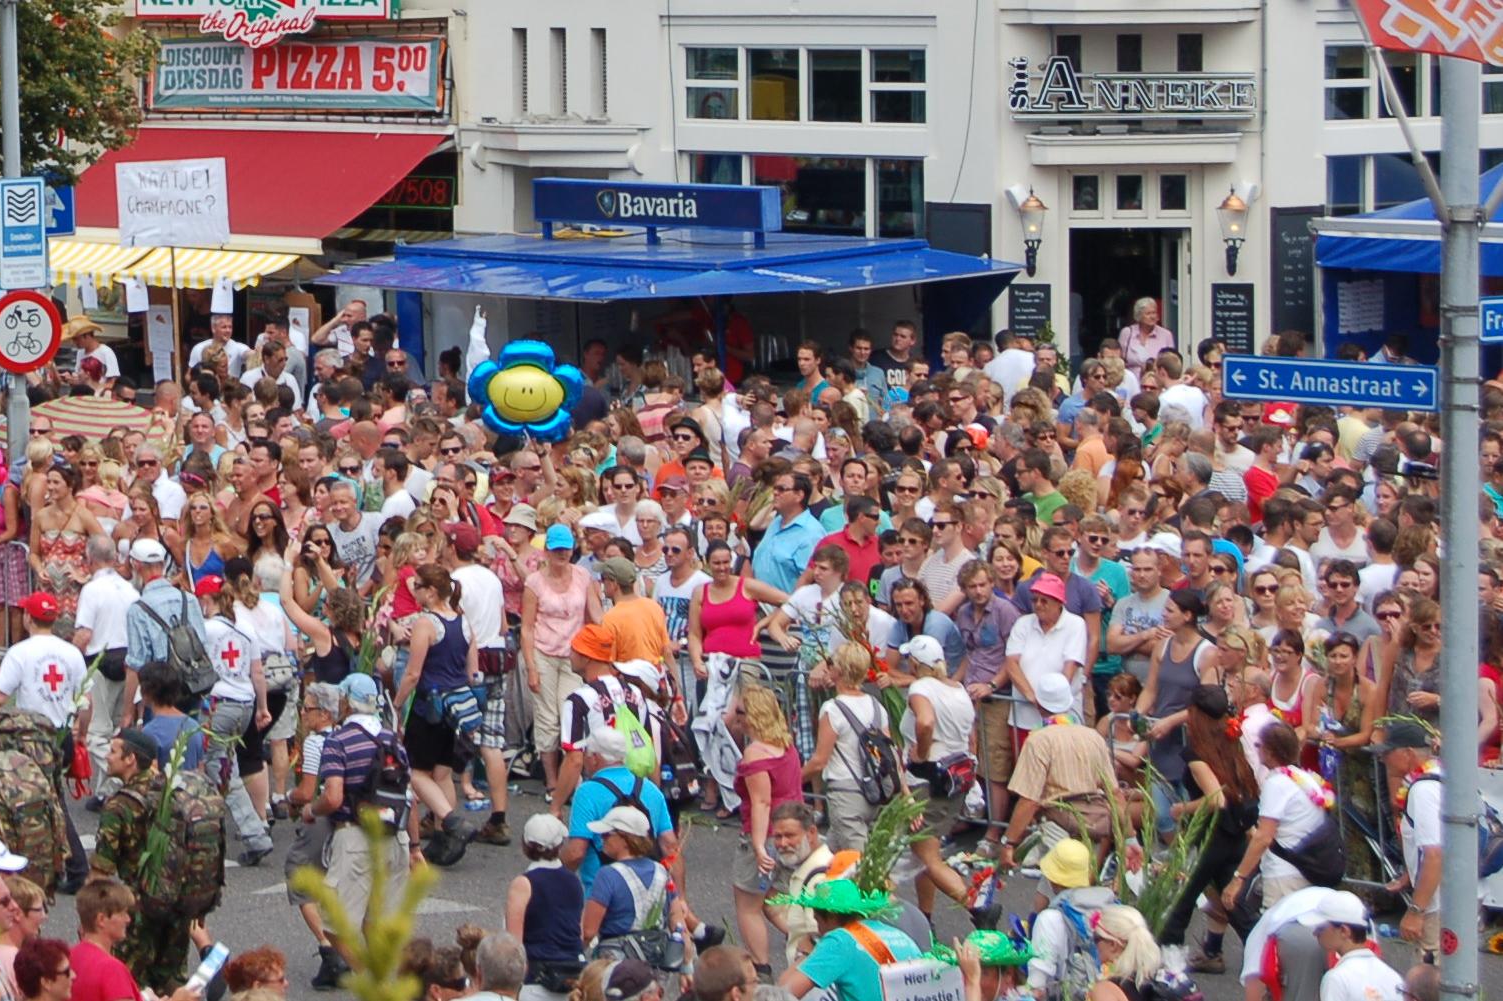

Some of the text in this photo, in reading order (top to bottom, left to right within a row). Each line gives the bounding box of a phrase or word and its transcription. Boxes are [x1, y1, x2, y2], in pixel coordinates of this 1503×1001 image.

[202, 7, 315, 45] the Original
[165, 46, 245, 69] DISCOUNT
[252, 46, 363, 90] PIZZA
[164, 67, 243, 91] DINSDAG
[1031, 56, 1258, 112] ANNEKE
[618, 192, 697, 218] Bavaria
[1486, 310, 1503, 330] Fr
[1258, 368, 1402, 397] St. Annastraat
[903, 972, 928, 986] Hier
